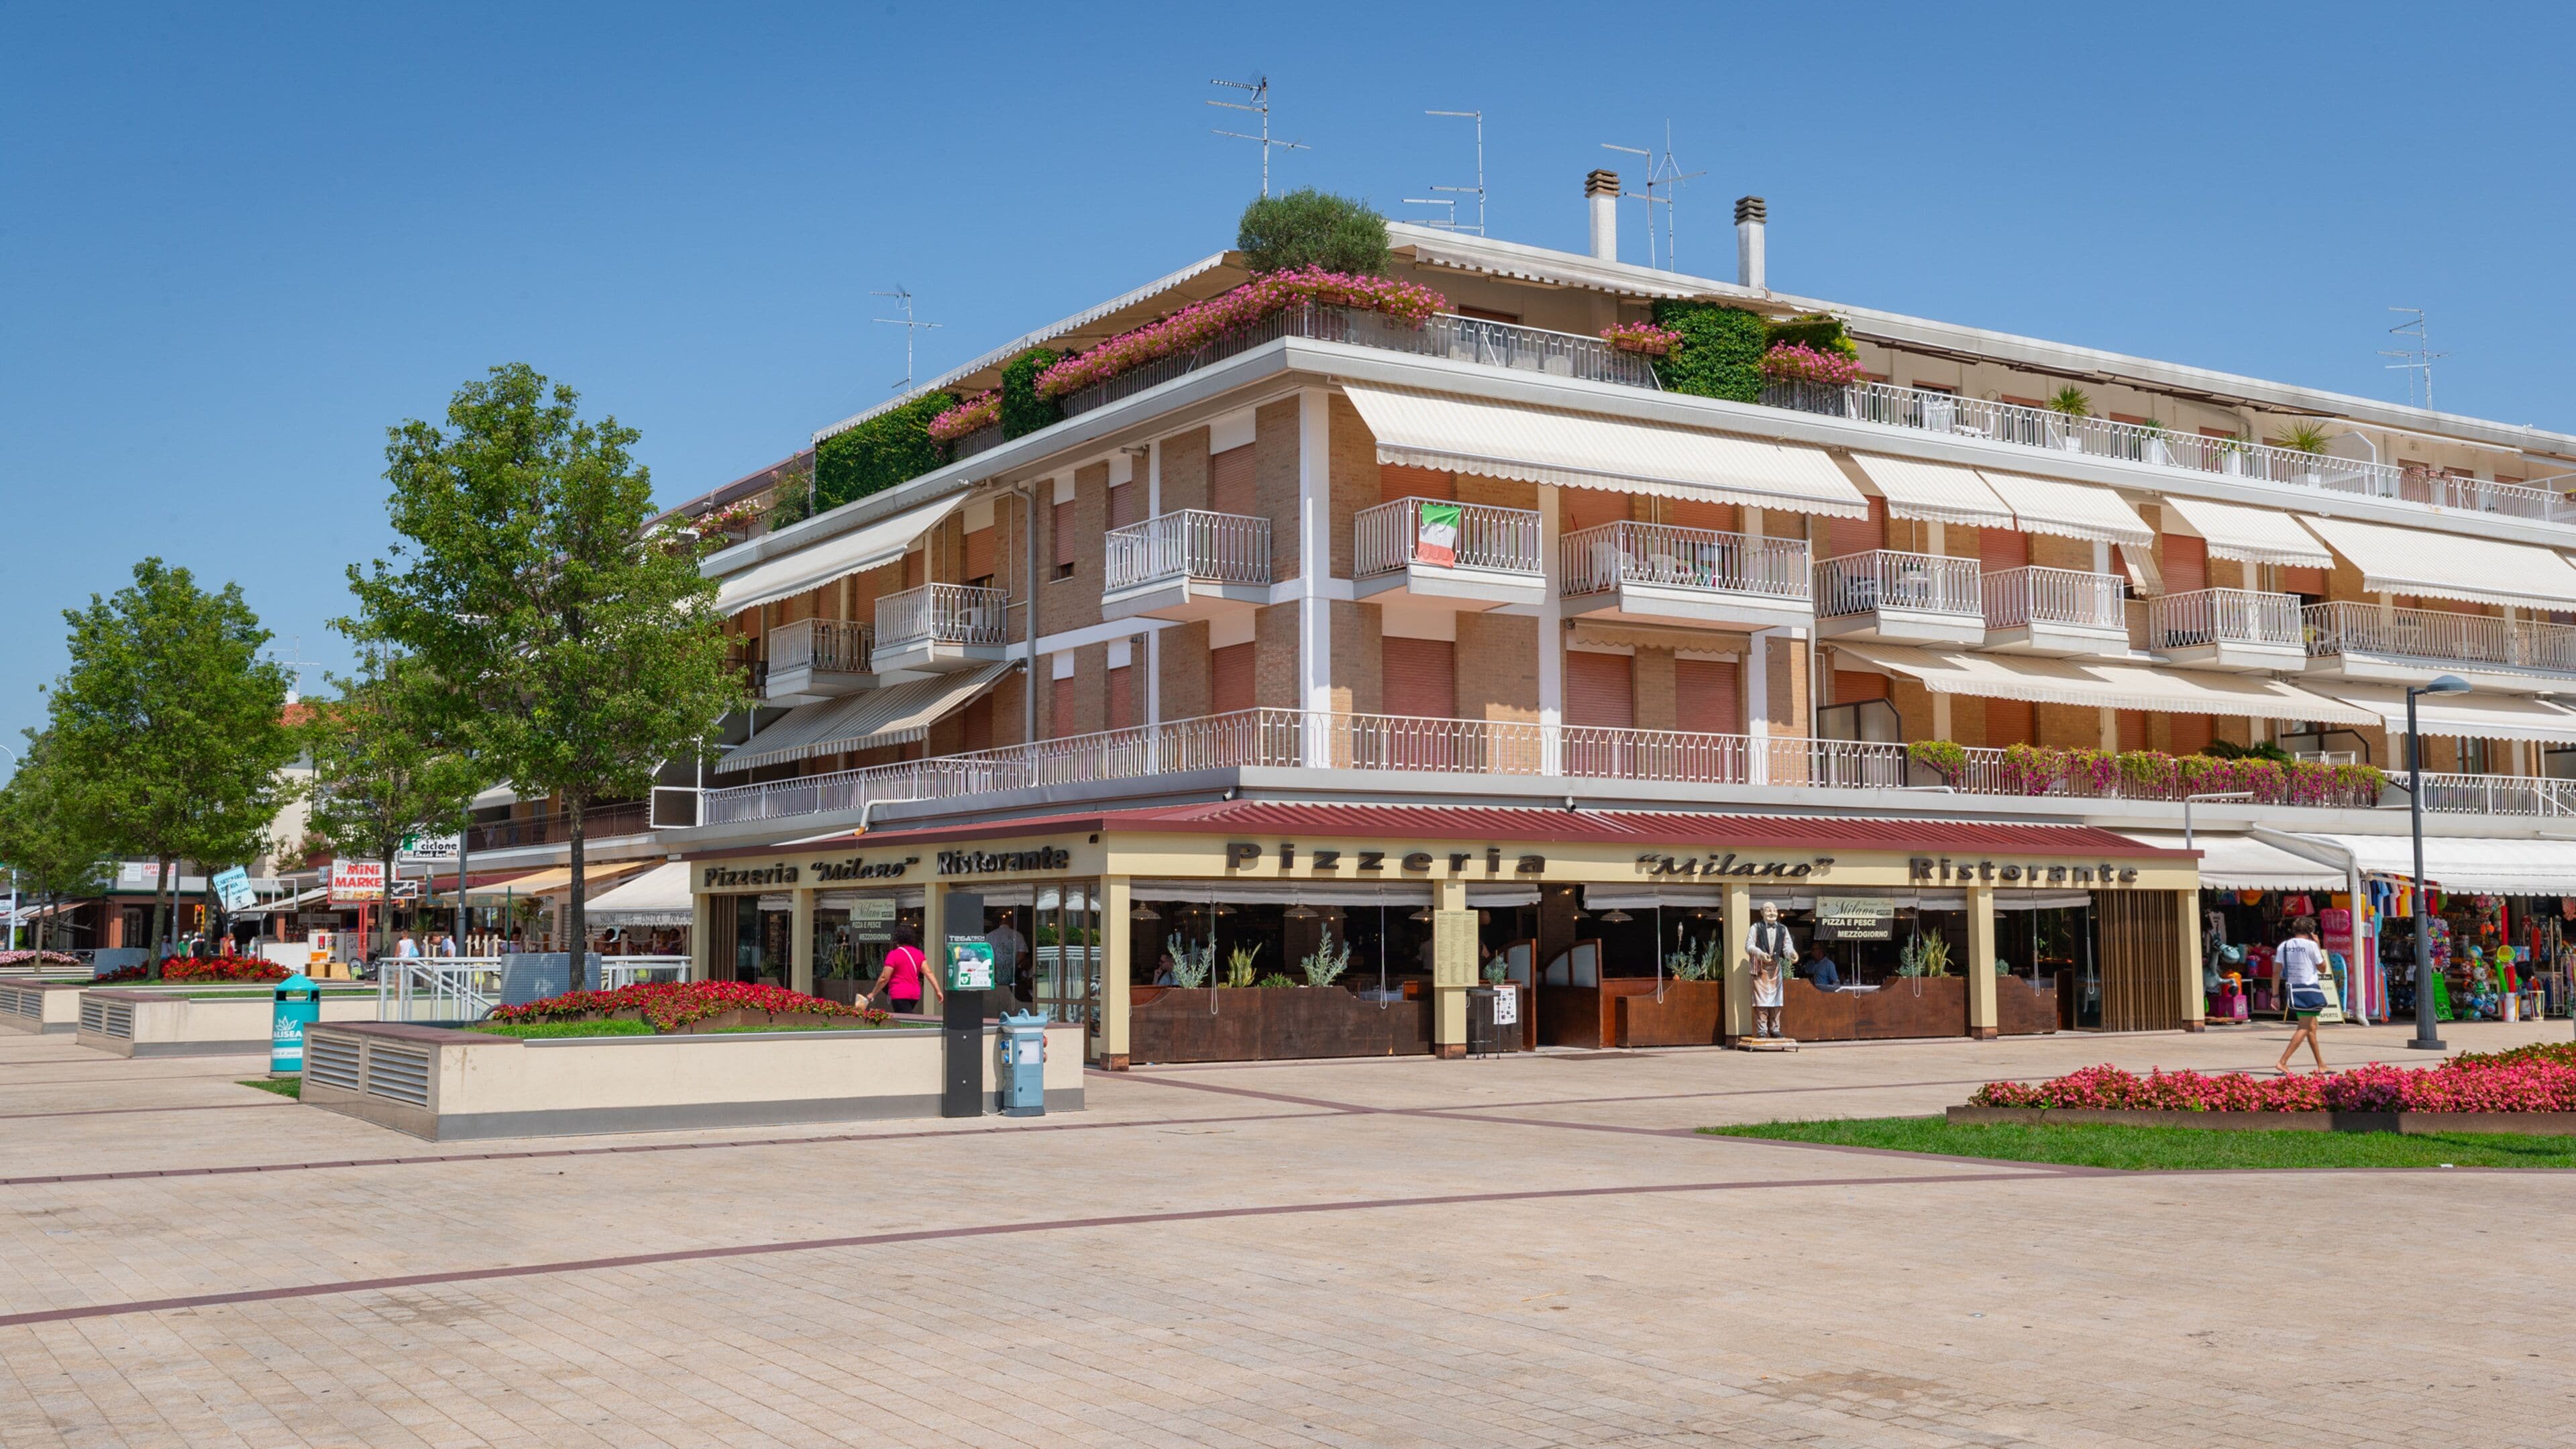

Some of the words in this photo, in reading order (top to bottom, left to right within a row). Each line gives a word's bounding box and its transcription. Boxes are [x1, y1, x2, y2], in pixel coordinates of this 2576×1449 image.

[421, 841, 458, 850] ciclone
[704, 863, 799, 887] Pizzeria
[937, 846, 1069, 875] Ristorante
[1226, 843, 1546, 873] Pizzeria
[1910, 858, 2138, 883] Ristorante
[335, 877, 386, 888] MARKE
[1834, 900, 1874, 916] Milano
[1822, 918, 1845, 926] PIZZA
[1847, 918, 1852, 926] E
[1854, 918, 1876, 926] PESCE
